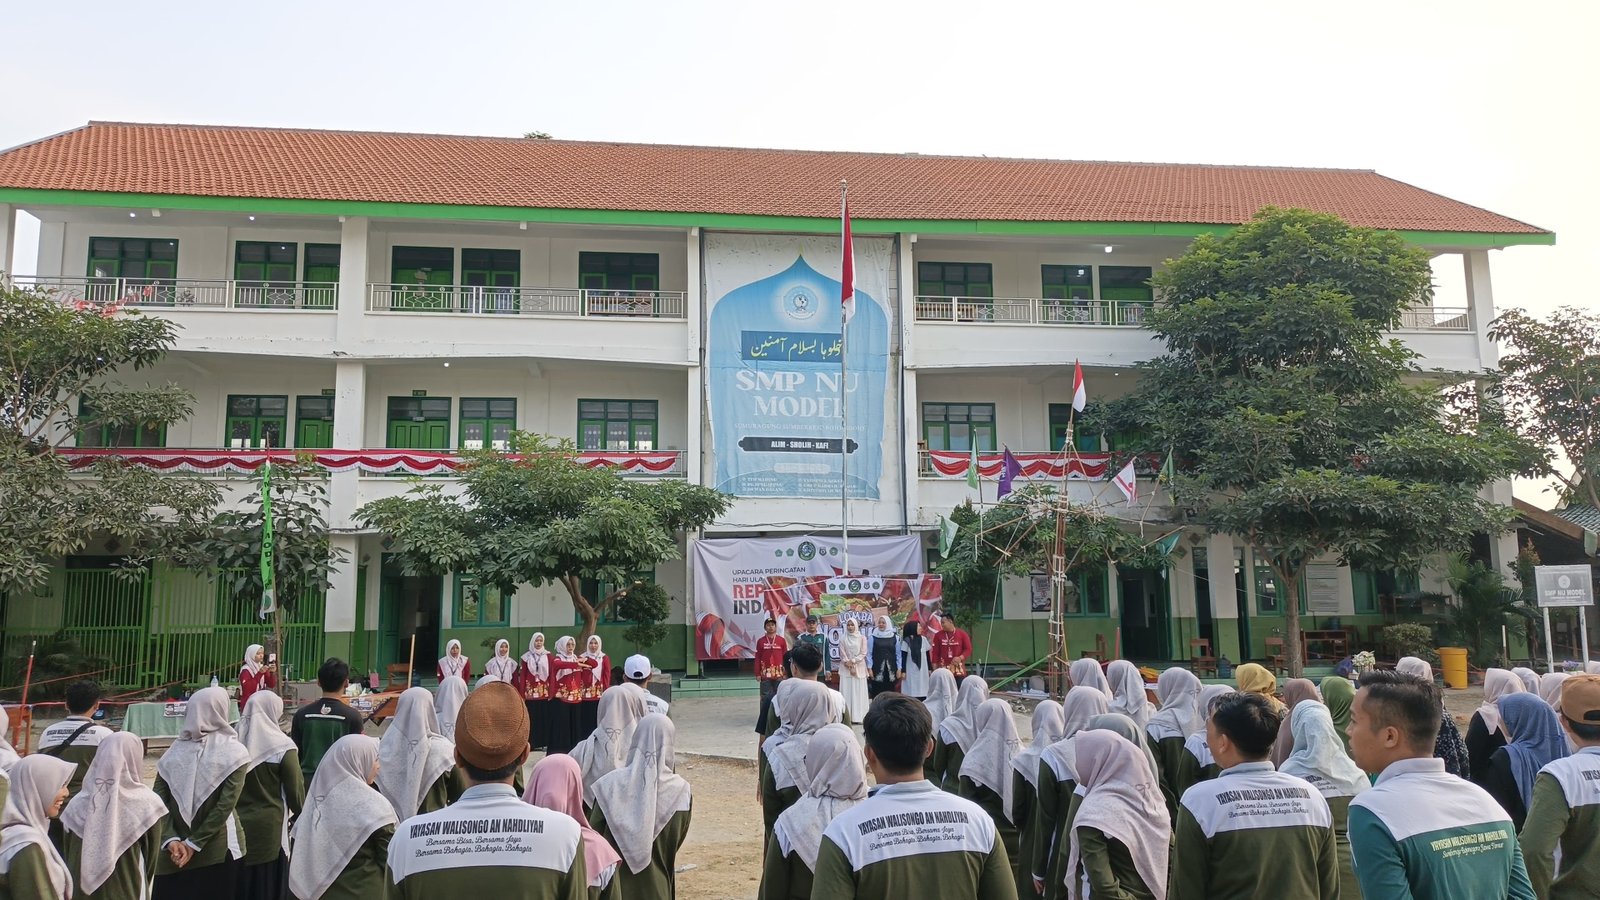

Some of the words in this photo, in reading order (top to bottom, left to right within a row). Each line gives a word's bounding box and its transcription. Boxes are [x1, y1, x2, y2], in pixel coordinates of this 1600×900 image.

[736, 370, 805, 392] SMP
[815, 372, 860, 393] NU
[753, 396, 844, 418] MODEL
[790, 441, 812, 449] SHOLIH
[765, 567, 806, 575] PERINGATAN
[838, 610, 873, 624] LOMBA
[1216, 790, 1242, 805] YAYASAN
[1242, 788, 1275, 801] WALISONGO
[1275, 788, 1283, 799] AN
[410, 822, 442, 839] YAYASAN
[442, 819, 489, 835] WALISONGO
[490, 820, 501, 833] AN
[502, 818, 544, 834] NAHDLIYAH
[858, 817, 887, 836] YAYASAN
[887, 814, 925, 829] WALISONGO
[925, 812, 935, 825] AN
[935, 811, 969, 824] NAHDLIYAH
[426, 838, 455, 846] Bersama
[475, 835, 505, 844] Bersama
[506, 834, 522, 844] Jaya
[877, 831, 902, 840] Bersama
[916, 827, 941, 835] Bersama
[941, 826, 955, 834] Jaya
[869, 841, 893, 851] Bersama
[1430, 838, 1452, 851] YAYASAN
[1451, 834, 1478, 847] WALISONGO
[1477, 832, 1485, 843] AN
[415, 848, 443, 857] Bersama
[505, 843, 532, 853] Bahagia
